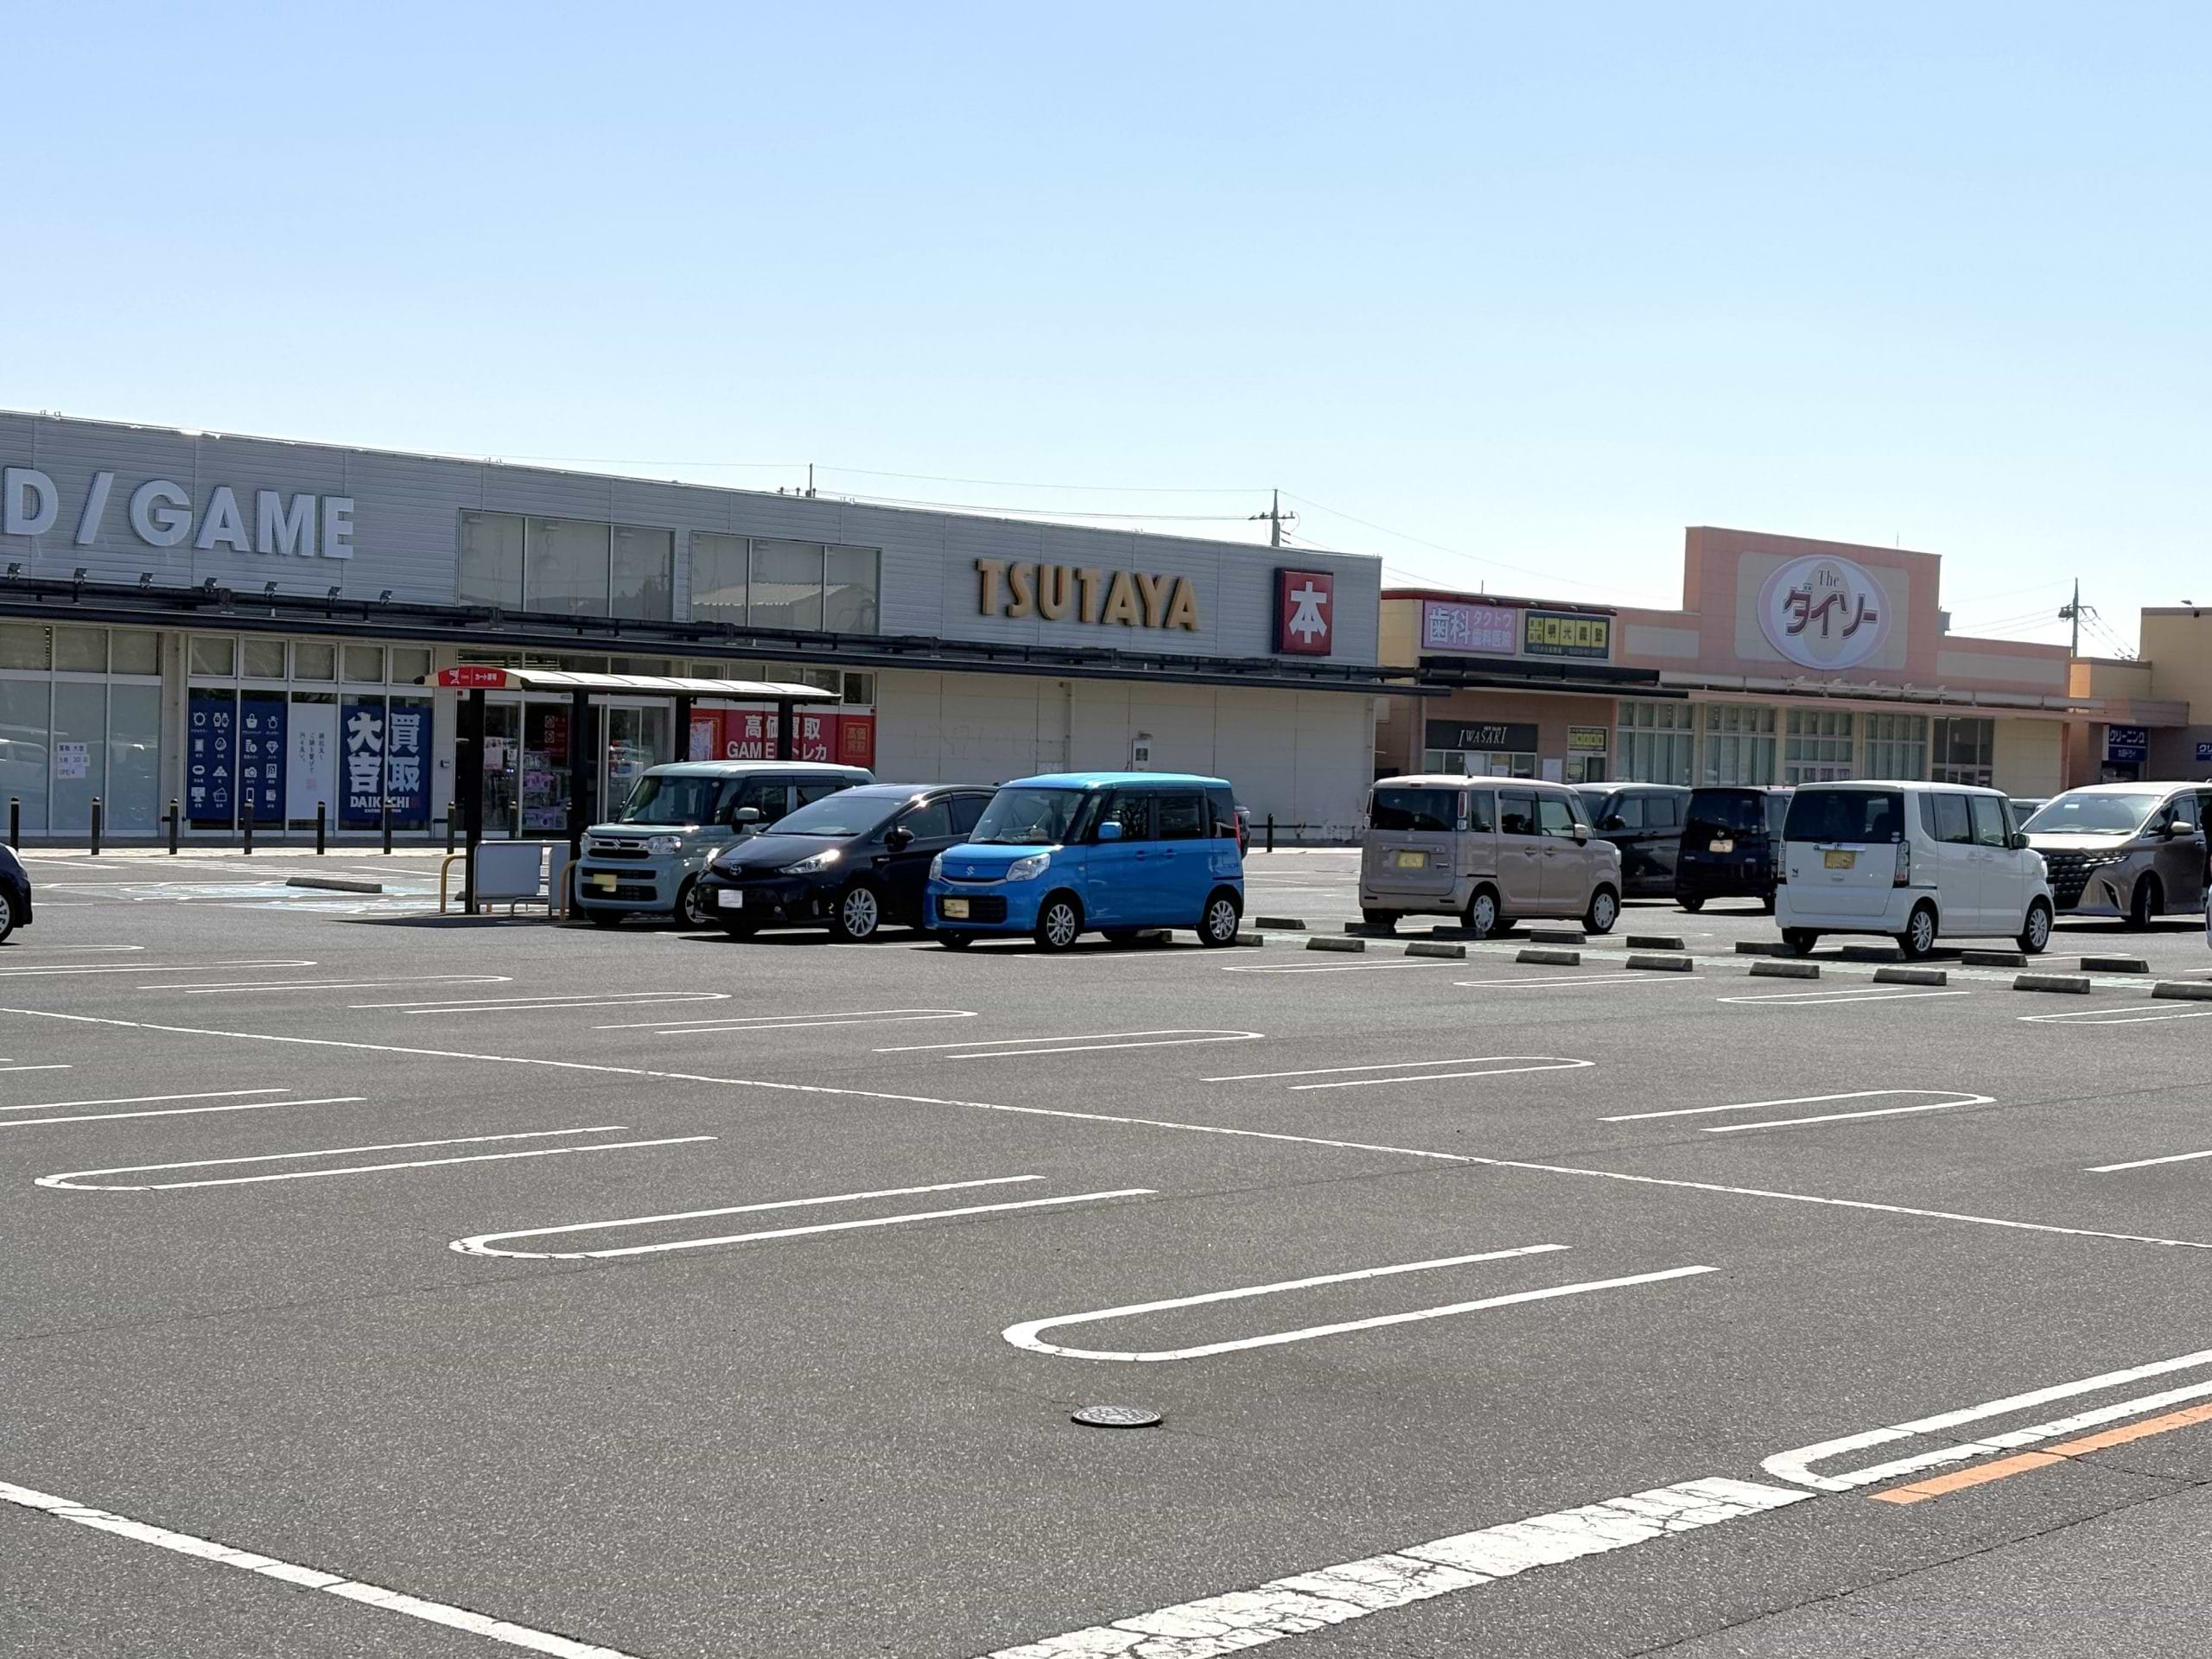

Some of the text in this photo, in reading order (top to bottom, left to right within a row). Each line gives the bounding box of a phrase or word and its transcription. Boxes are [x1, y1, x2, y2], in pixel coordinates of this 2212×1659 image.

[130, 480, 355, 559] GAME
[976, 557, 1201, 631] TSUTAYA
[1818, 569, 1840, 588] The
[1289, 581, 1327, 644] 本
[1429, 608, 1471, 645] 歯科
[1473, 610, 1512, 628] タクトウ
[1783, 583, 1879, 639] ダイソー
[1471, 628, 1511, 648] 歯科医院
[346, 711, 384, 793] 大吉
[389, 713, 421, 792] 買取
[727, 741, 775, 759] GAME
[1458, 727, 1507, 747] IWASAKI
[2109, 729, 2145, 744] クリーニング
